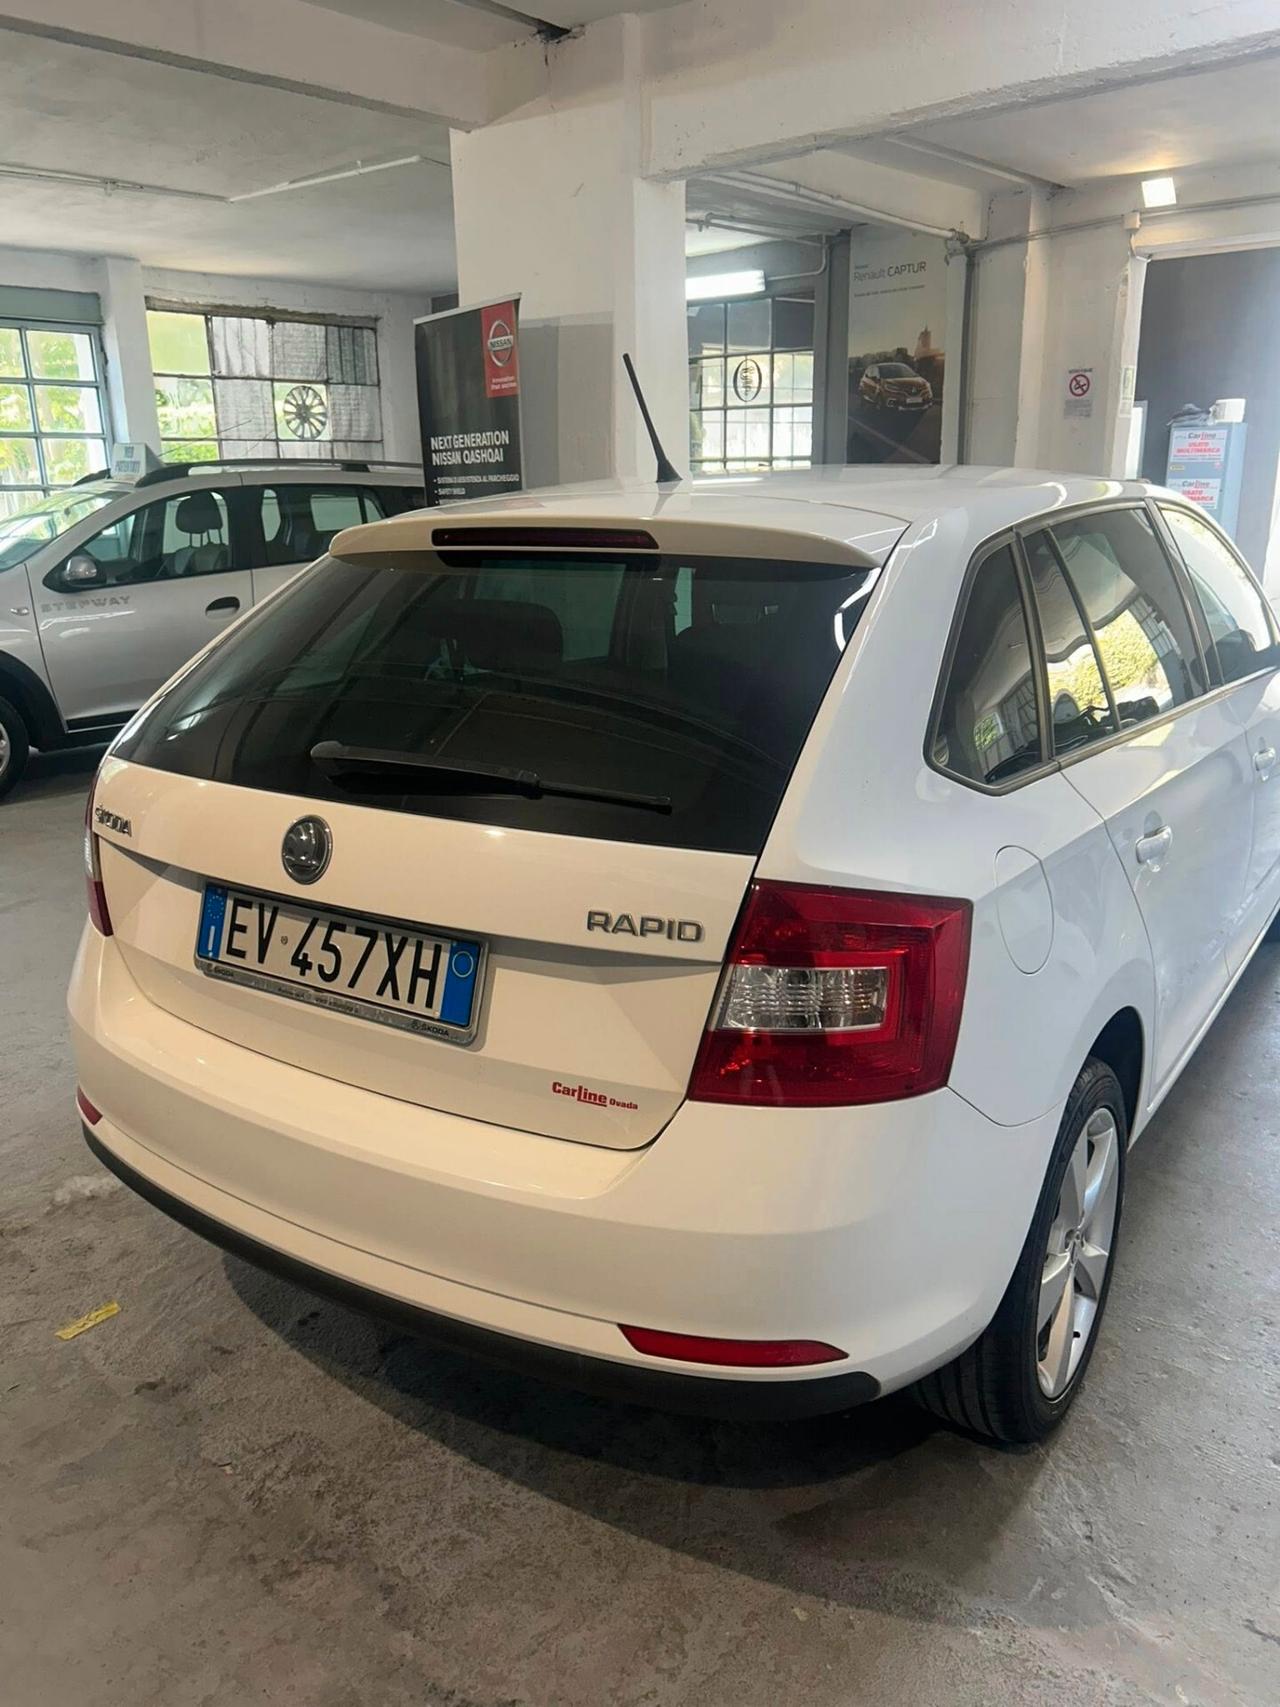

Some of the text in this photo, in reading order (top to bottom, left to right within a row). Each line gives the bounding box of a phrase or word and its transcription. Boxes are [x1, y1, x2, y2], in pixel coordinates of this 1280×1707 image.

[887, 261, 927, 277] CAPTUR
[490, 338, 513, 349] NISSAN
[431, 430, 510, 450] NEXT GENERATION
[432, 448, 504, 466] NISSAN QASHQAI
[40, 595, 131, 613] STEPWAY
[586, 910, 704, 943] RAPID
[226, 897, 280, 964] EV
[290, 917, 443, 1010] 457XH
[609, 1097, 639, 1110] Ovada
